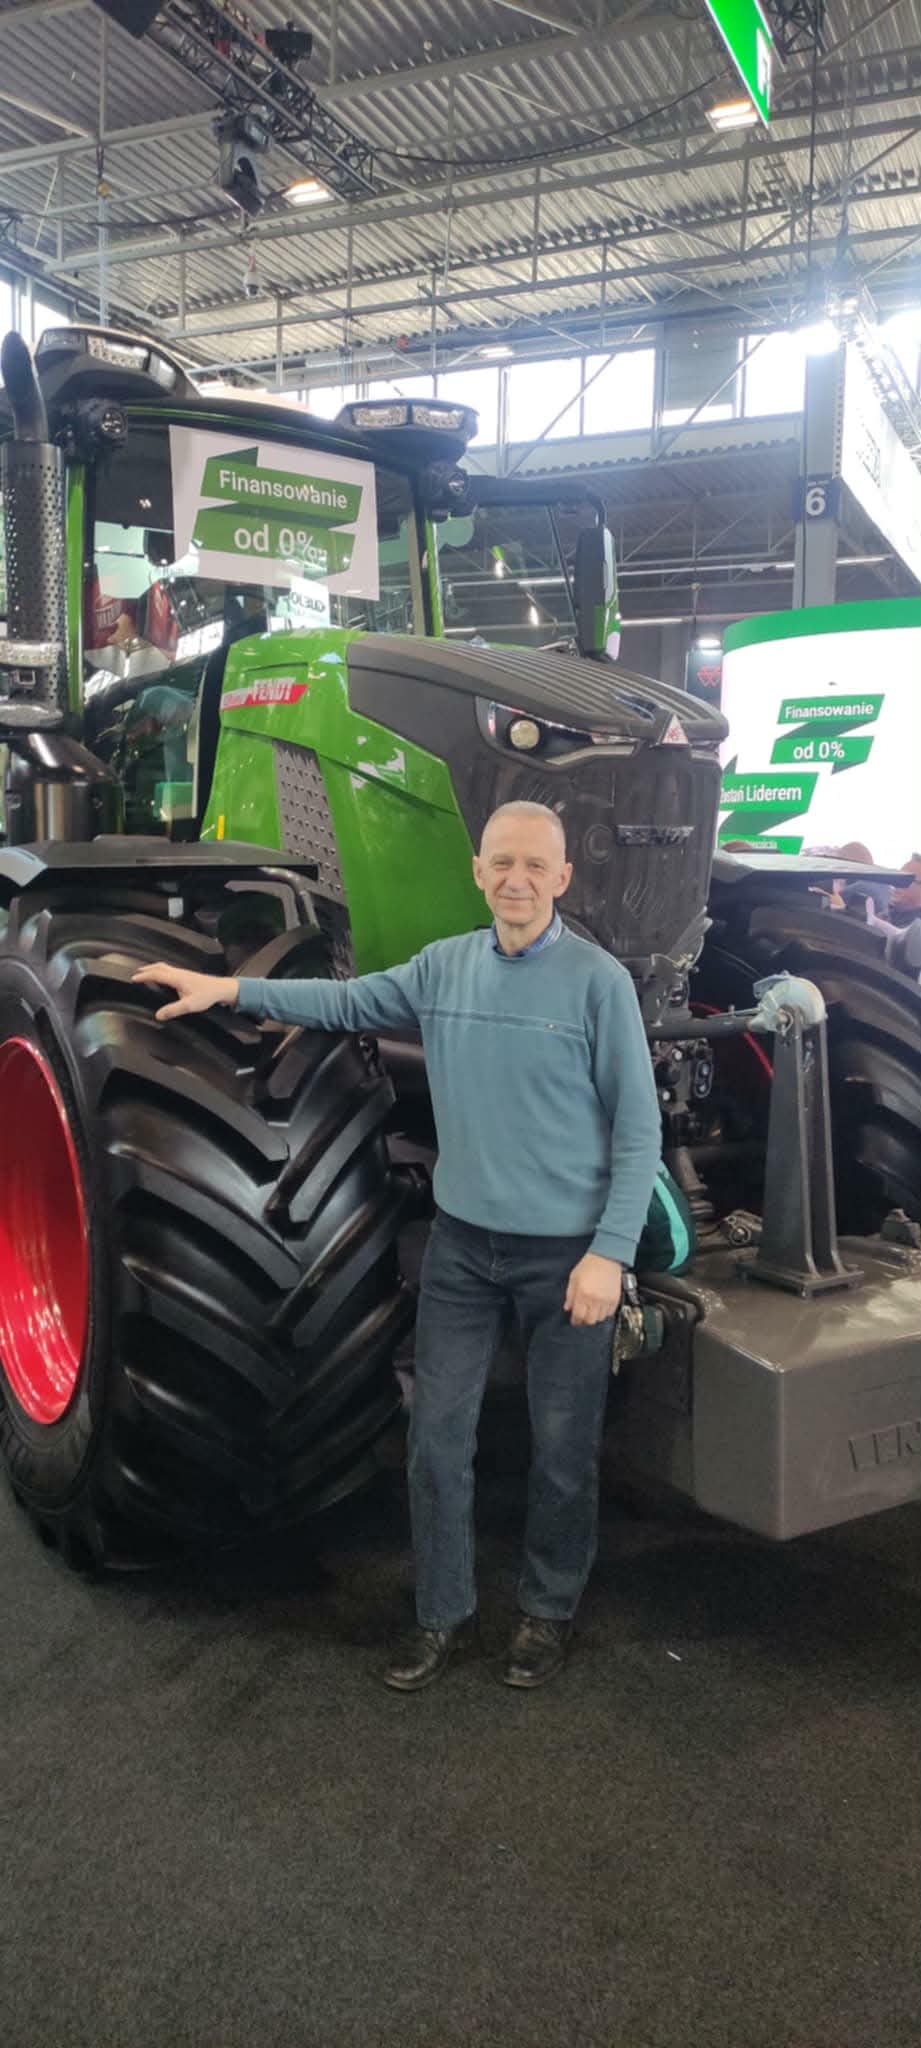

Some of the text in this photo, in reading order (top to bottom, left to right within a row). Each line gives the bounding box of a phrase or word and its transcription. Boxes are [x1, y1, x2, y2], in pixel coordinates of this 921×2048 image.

[219, 469, 348, 509] Finansowanie
[805, 487, 826, 516] 6
[234, 524, 321, 561] od 0%
[785, 702, 874, 719] Finansowanie
[793, 741, 845, 759] od 0%
[746, 784, 802, 802] Liderem
